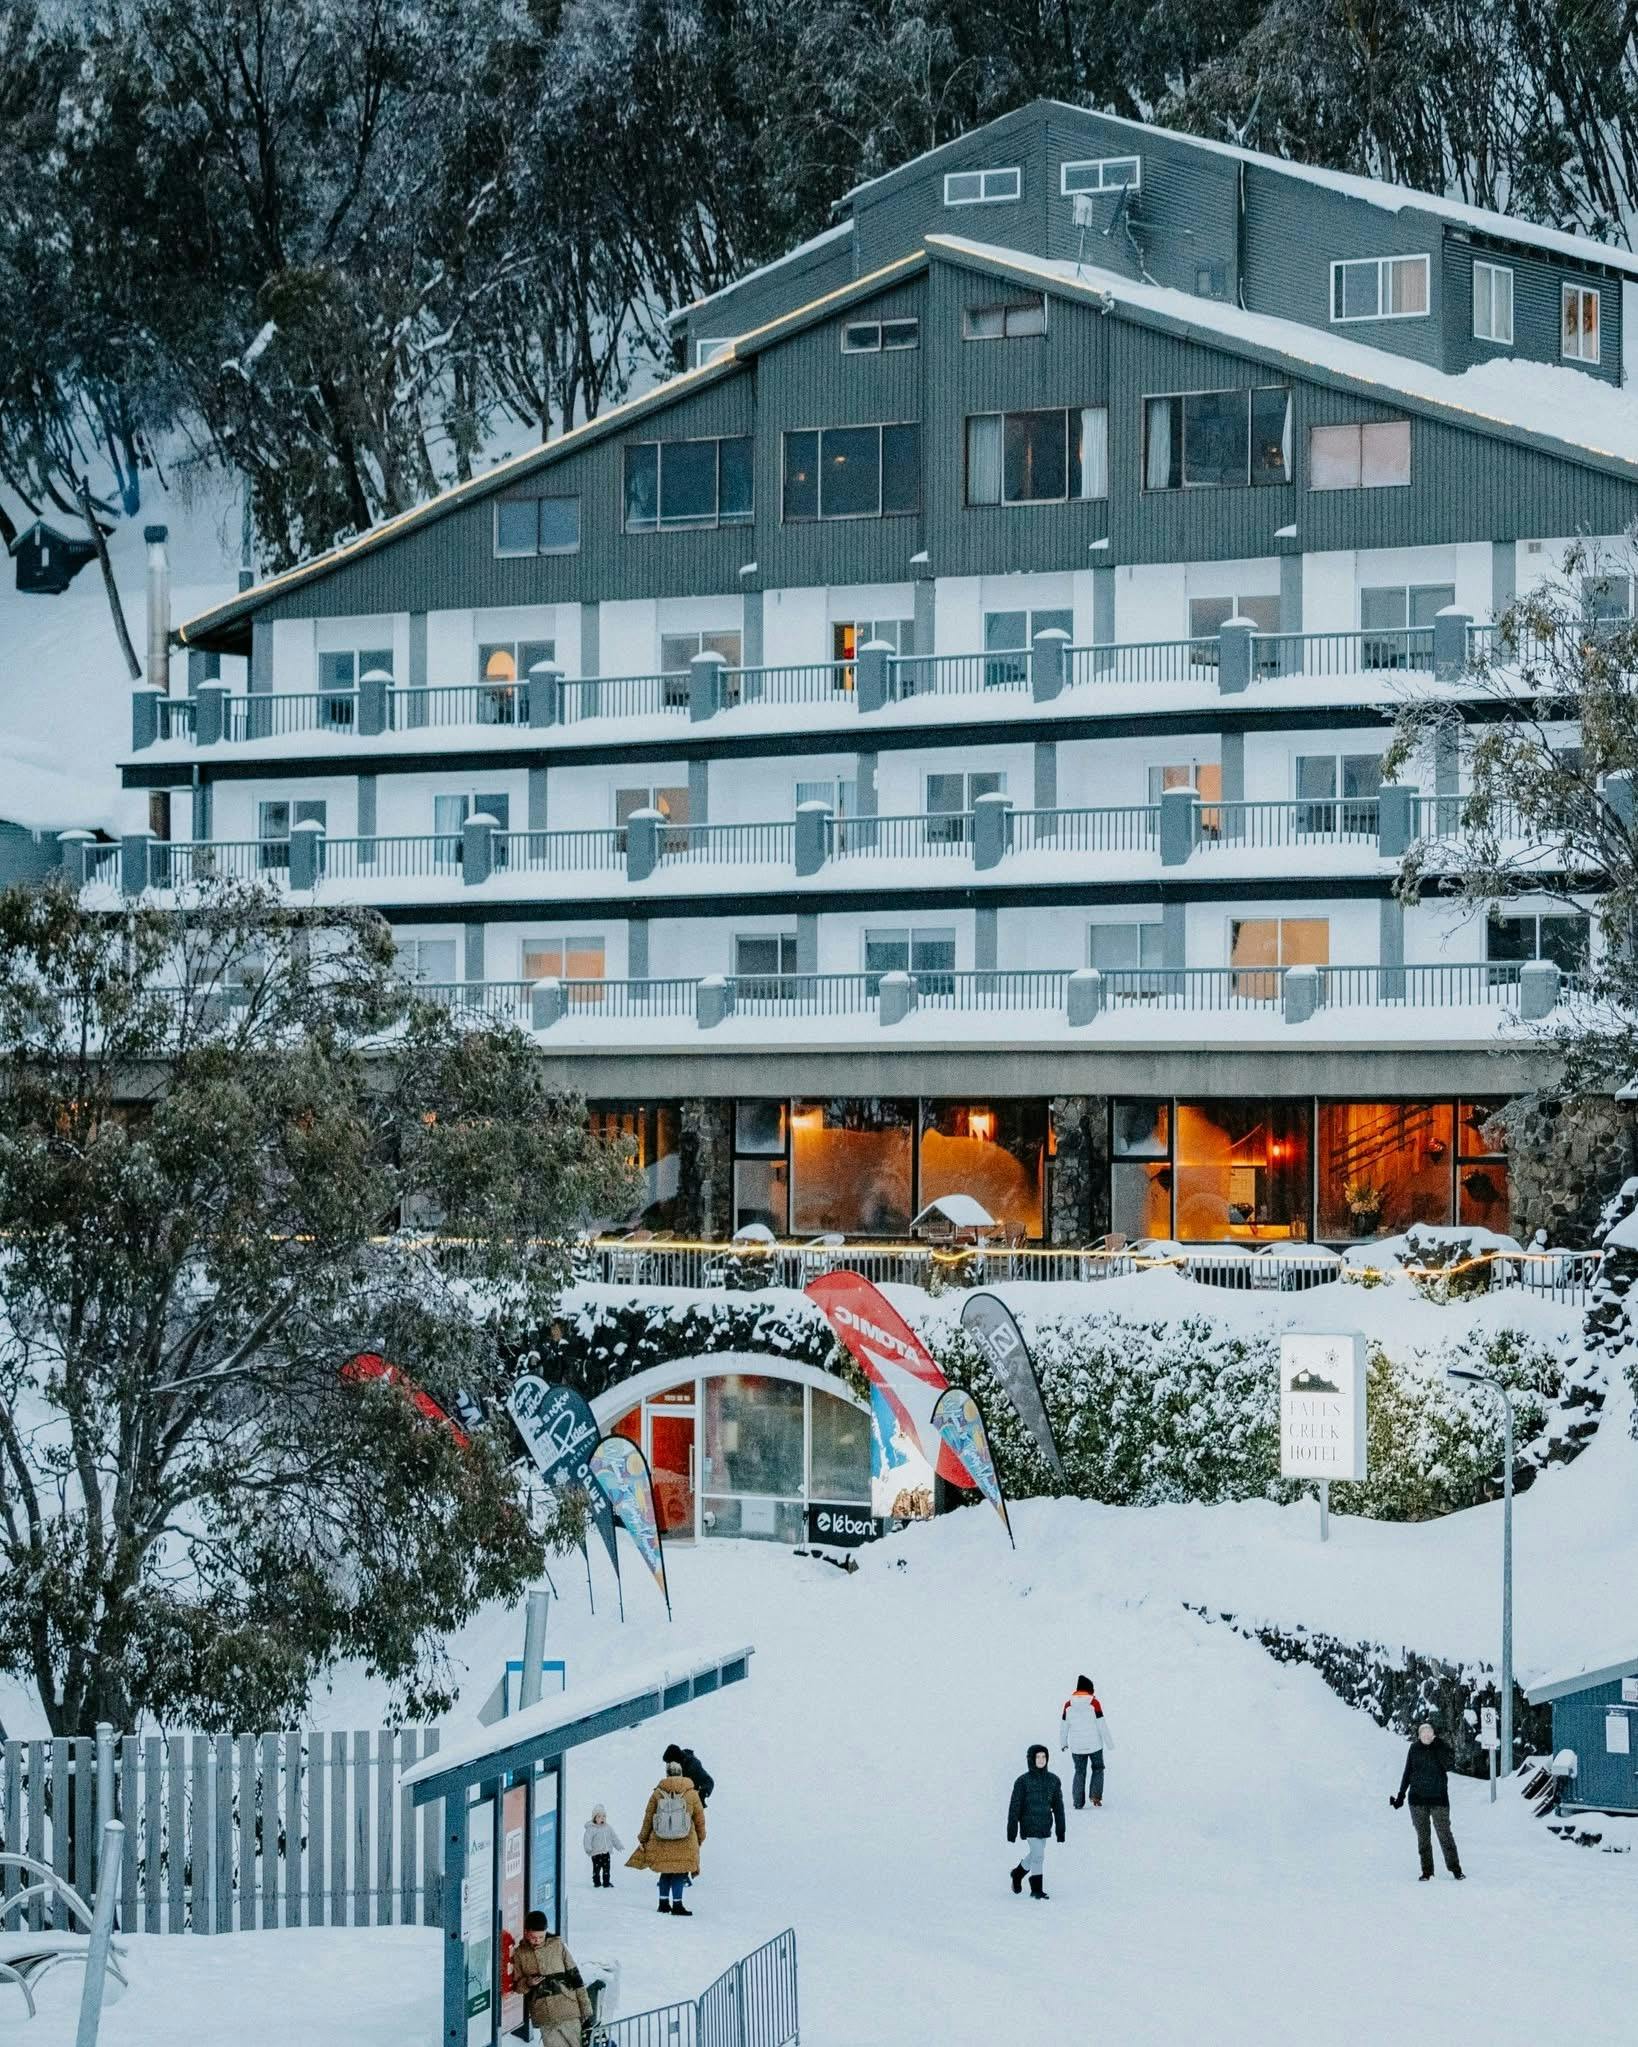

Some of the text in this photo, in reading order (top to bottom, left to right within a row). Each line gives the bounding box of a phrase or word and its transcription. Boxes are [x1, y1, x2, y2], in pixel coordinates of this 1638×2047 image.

[1289, 1401, 1344, 1417] FALLS
[1289, 1423, 1340, 1440] CREEK
[1290, 1445, 1341, 1461] HOTEL
[577, 1463, 607, 1514] OPEN
[832, 1513, 877, 1536] lébent
